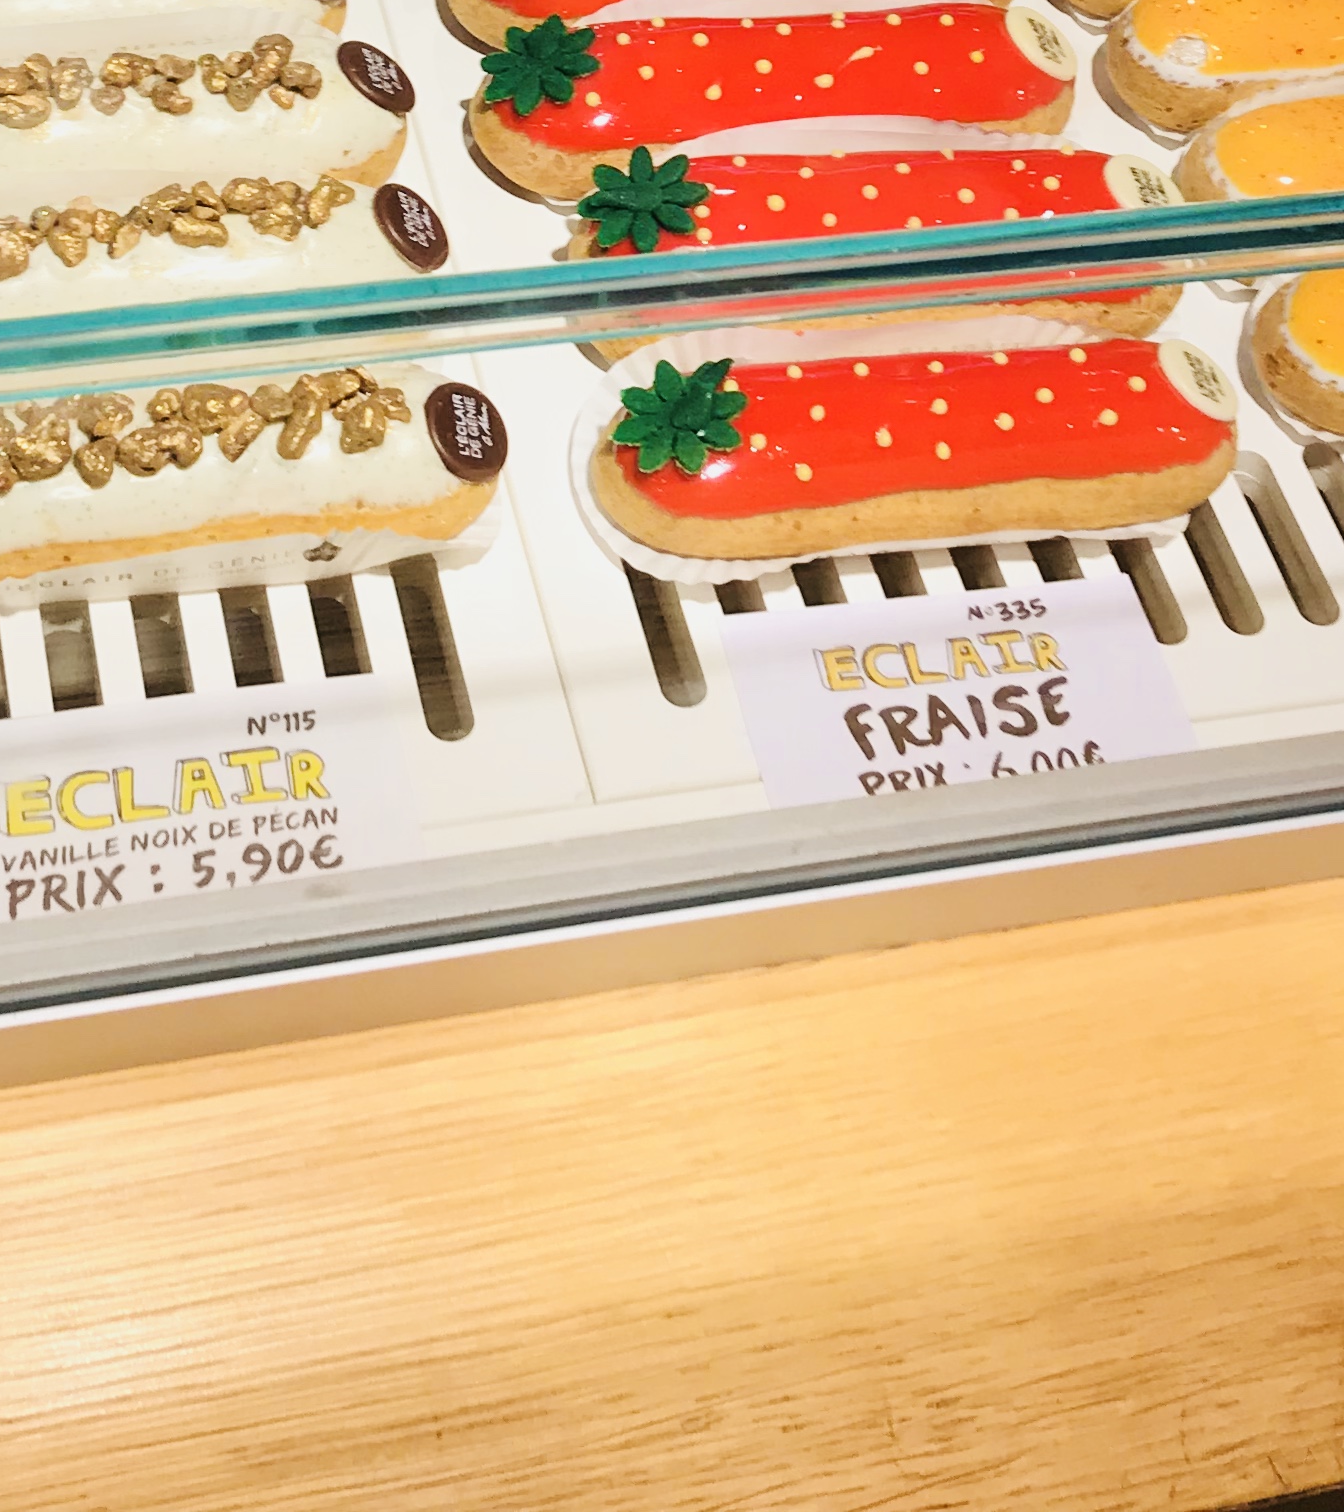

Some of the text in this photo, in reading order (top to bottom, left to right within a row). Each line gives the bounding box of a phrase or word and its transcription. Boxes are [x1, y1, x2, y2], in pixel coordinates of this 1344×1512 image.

[812, 629, 1069, 691] ECLAIR
[247, 710, 317, 737] N°115
[844, 677, 1071, 760] FRAISE
[2, 806, 338, 873] VANILLE NOIX DE PÉCAN
[6, 864, 124, 920] PRIX
[193, 834, 344, 888] 5,90€
